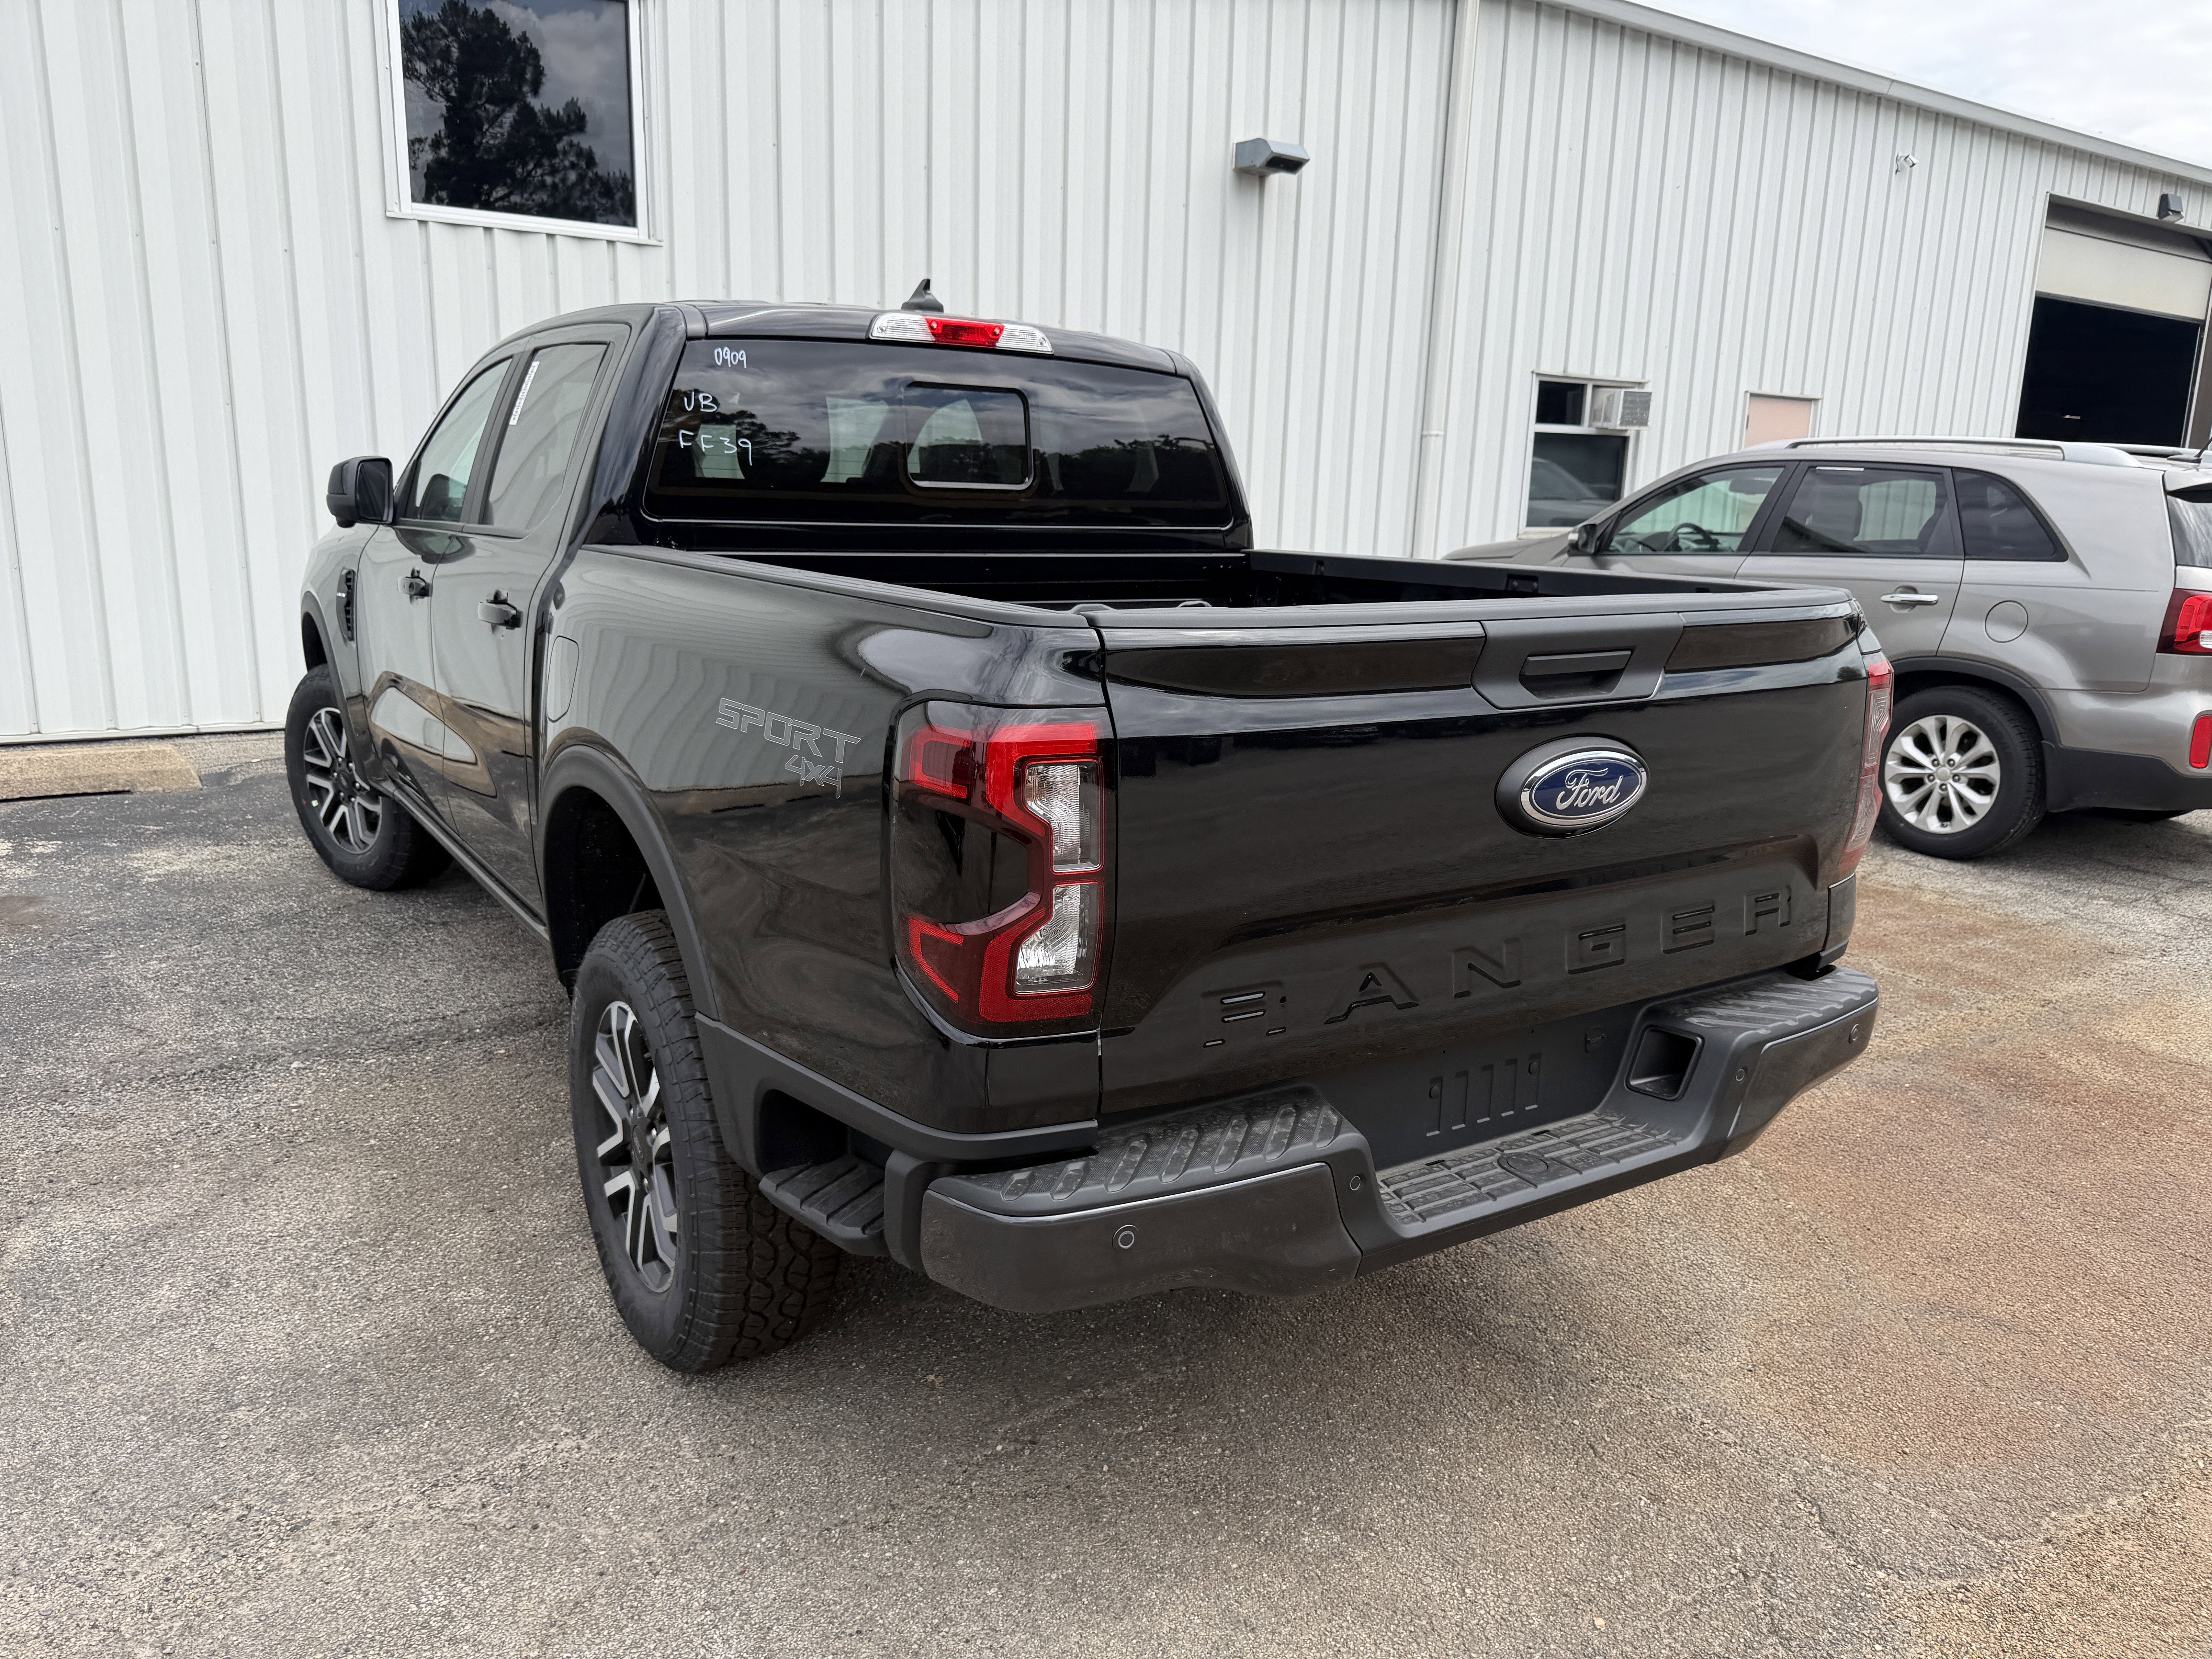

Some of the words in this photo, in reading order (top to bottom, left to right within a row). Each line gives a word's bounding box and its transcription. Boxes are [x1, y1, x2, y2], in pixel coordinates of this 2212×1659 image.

[714, 347, 747, 368] 0909
[679, 429, 752, 466] FF39
[716, 697, 862, 763] SPORT
[1556, 768, 1623, 810] Ford
[1201, 884, 1792, 1048] RANGER
